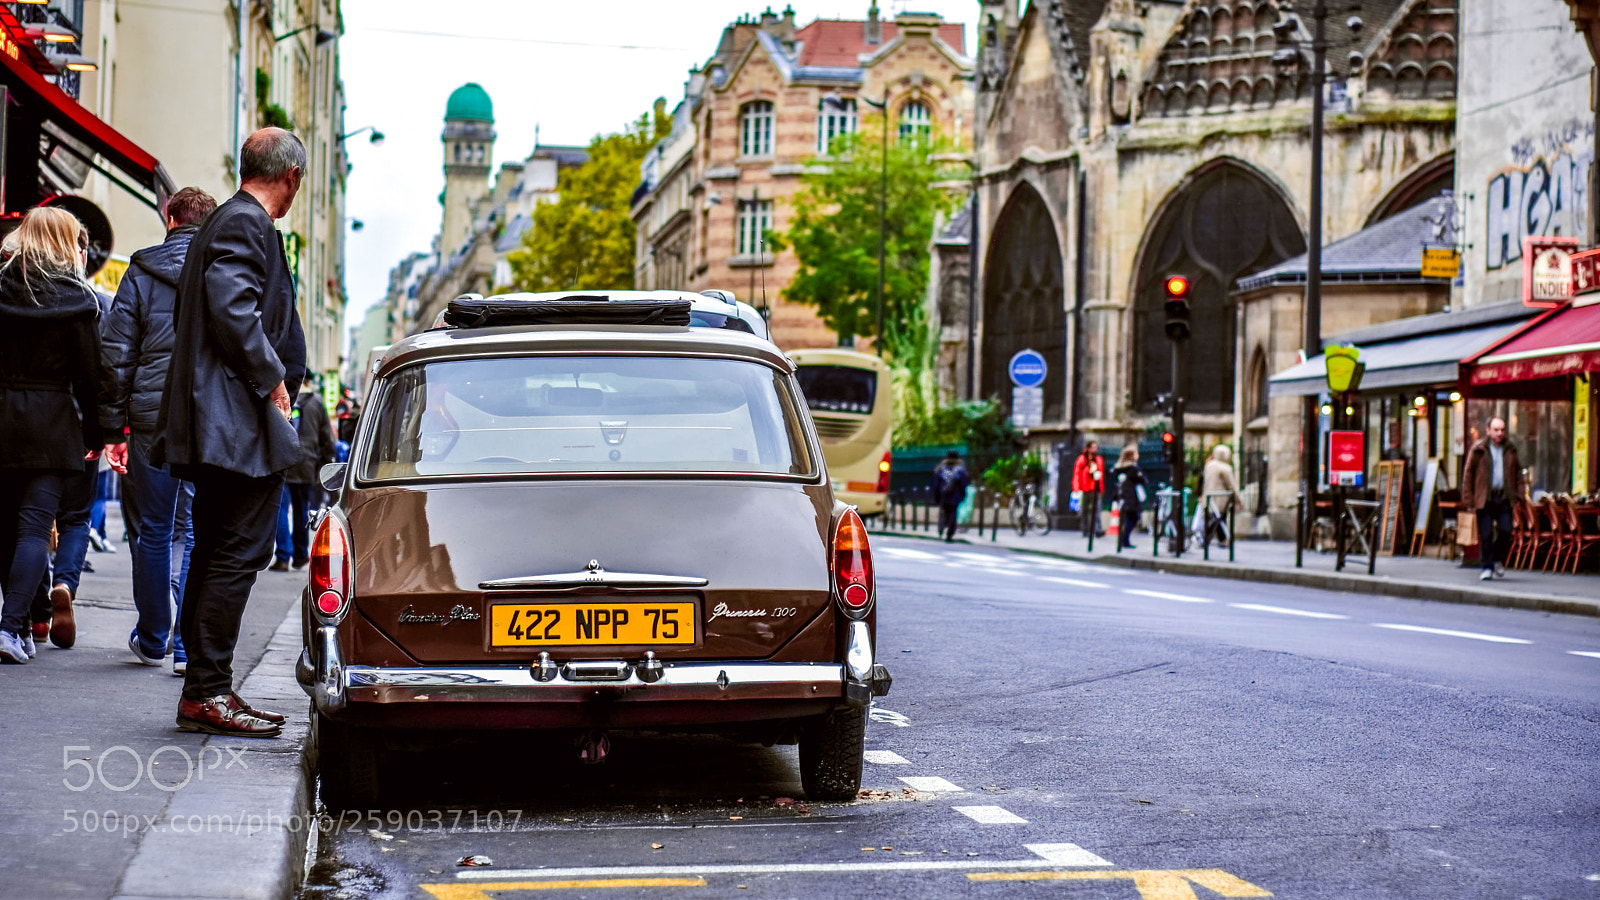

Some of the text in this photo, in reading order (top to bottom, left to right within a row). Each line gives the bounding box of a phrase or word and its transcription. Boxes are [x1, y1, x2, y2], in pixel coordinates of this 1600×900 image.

[507, 608, 679, 640] 422 NPP 75
[707, 601, 797, 623] Princess 1300
